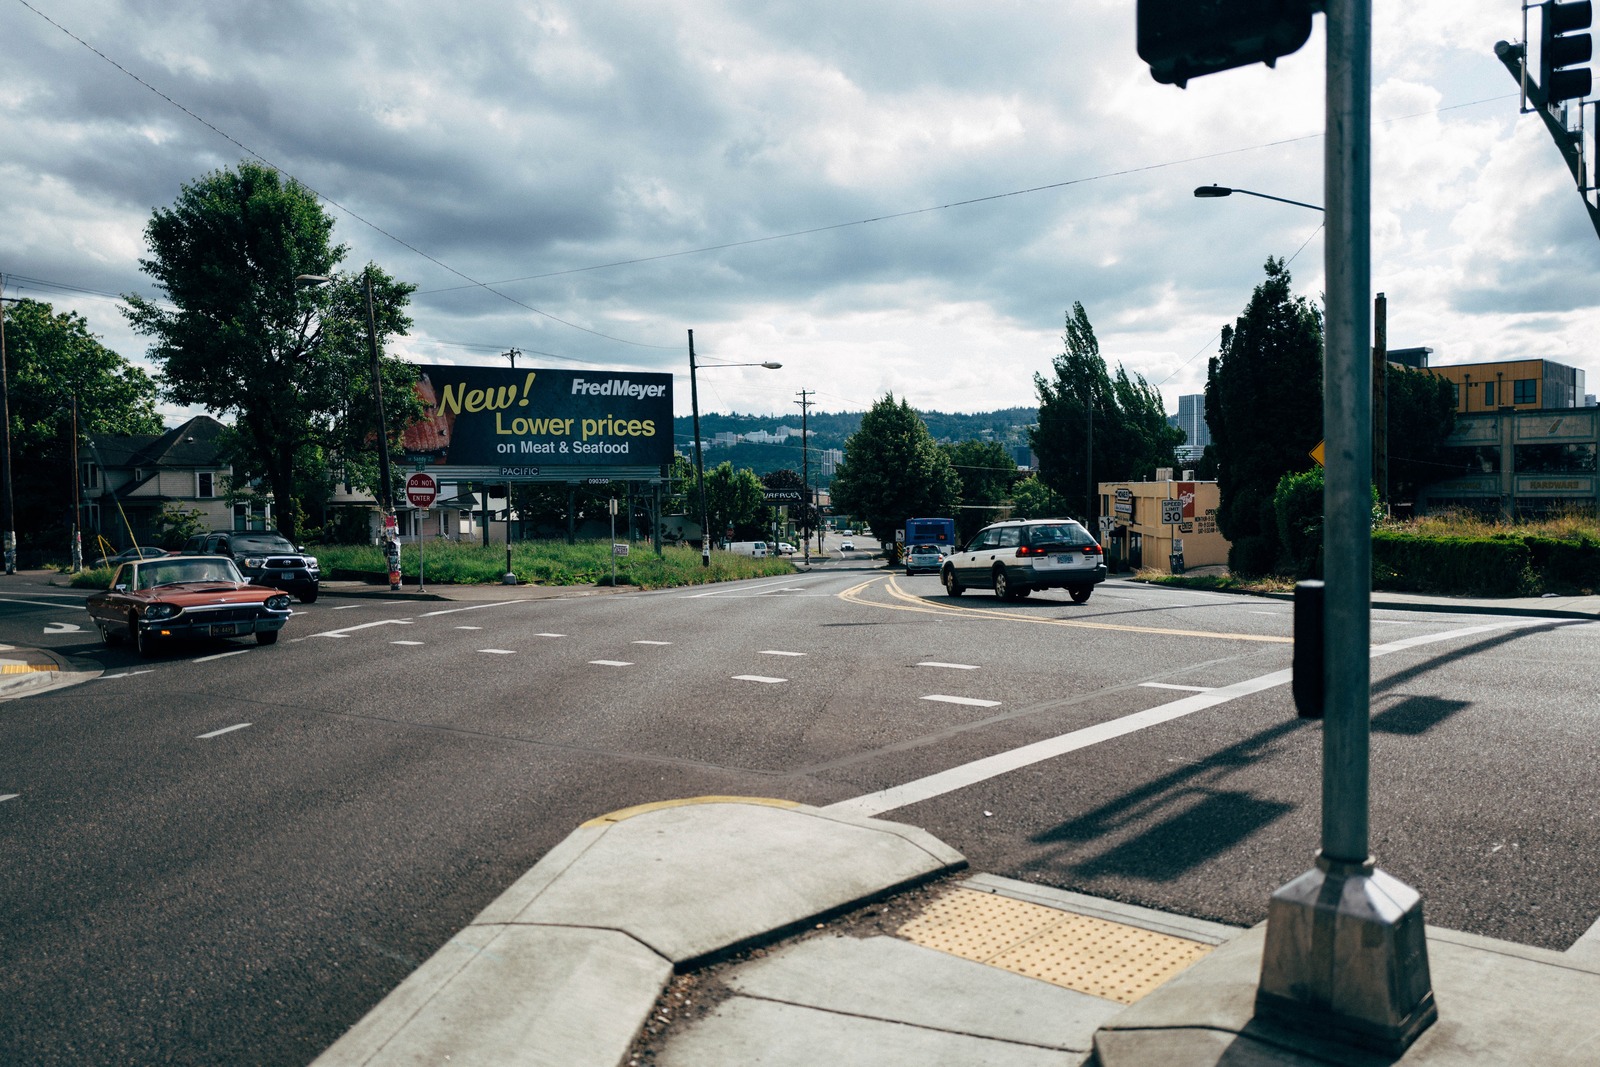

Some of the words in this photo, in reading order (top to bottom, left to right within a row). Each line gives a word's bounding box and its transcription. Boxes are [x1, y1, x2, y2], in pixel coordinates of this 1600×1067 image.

[437, 372, 536, 417] New!
[496, 412, 575, 436] Lower
[582, 413, 656, 441] prices
[497, 443, 516, 454] on
[520, 440, 555, 454] Meat
[558, 441, 569, 454] &
[573, 441, 629, 454] Seafood
[502, 467, 539, 475] PACIFIC
[1530, 481, 1579, 489] HARDWARE
[1164, 512, 1181, 522] 30
